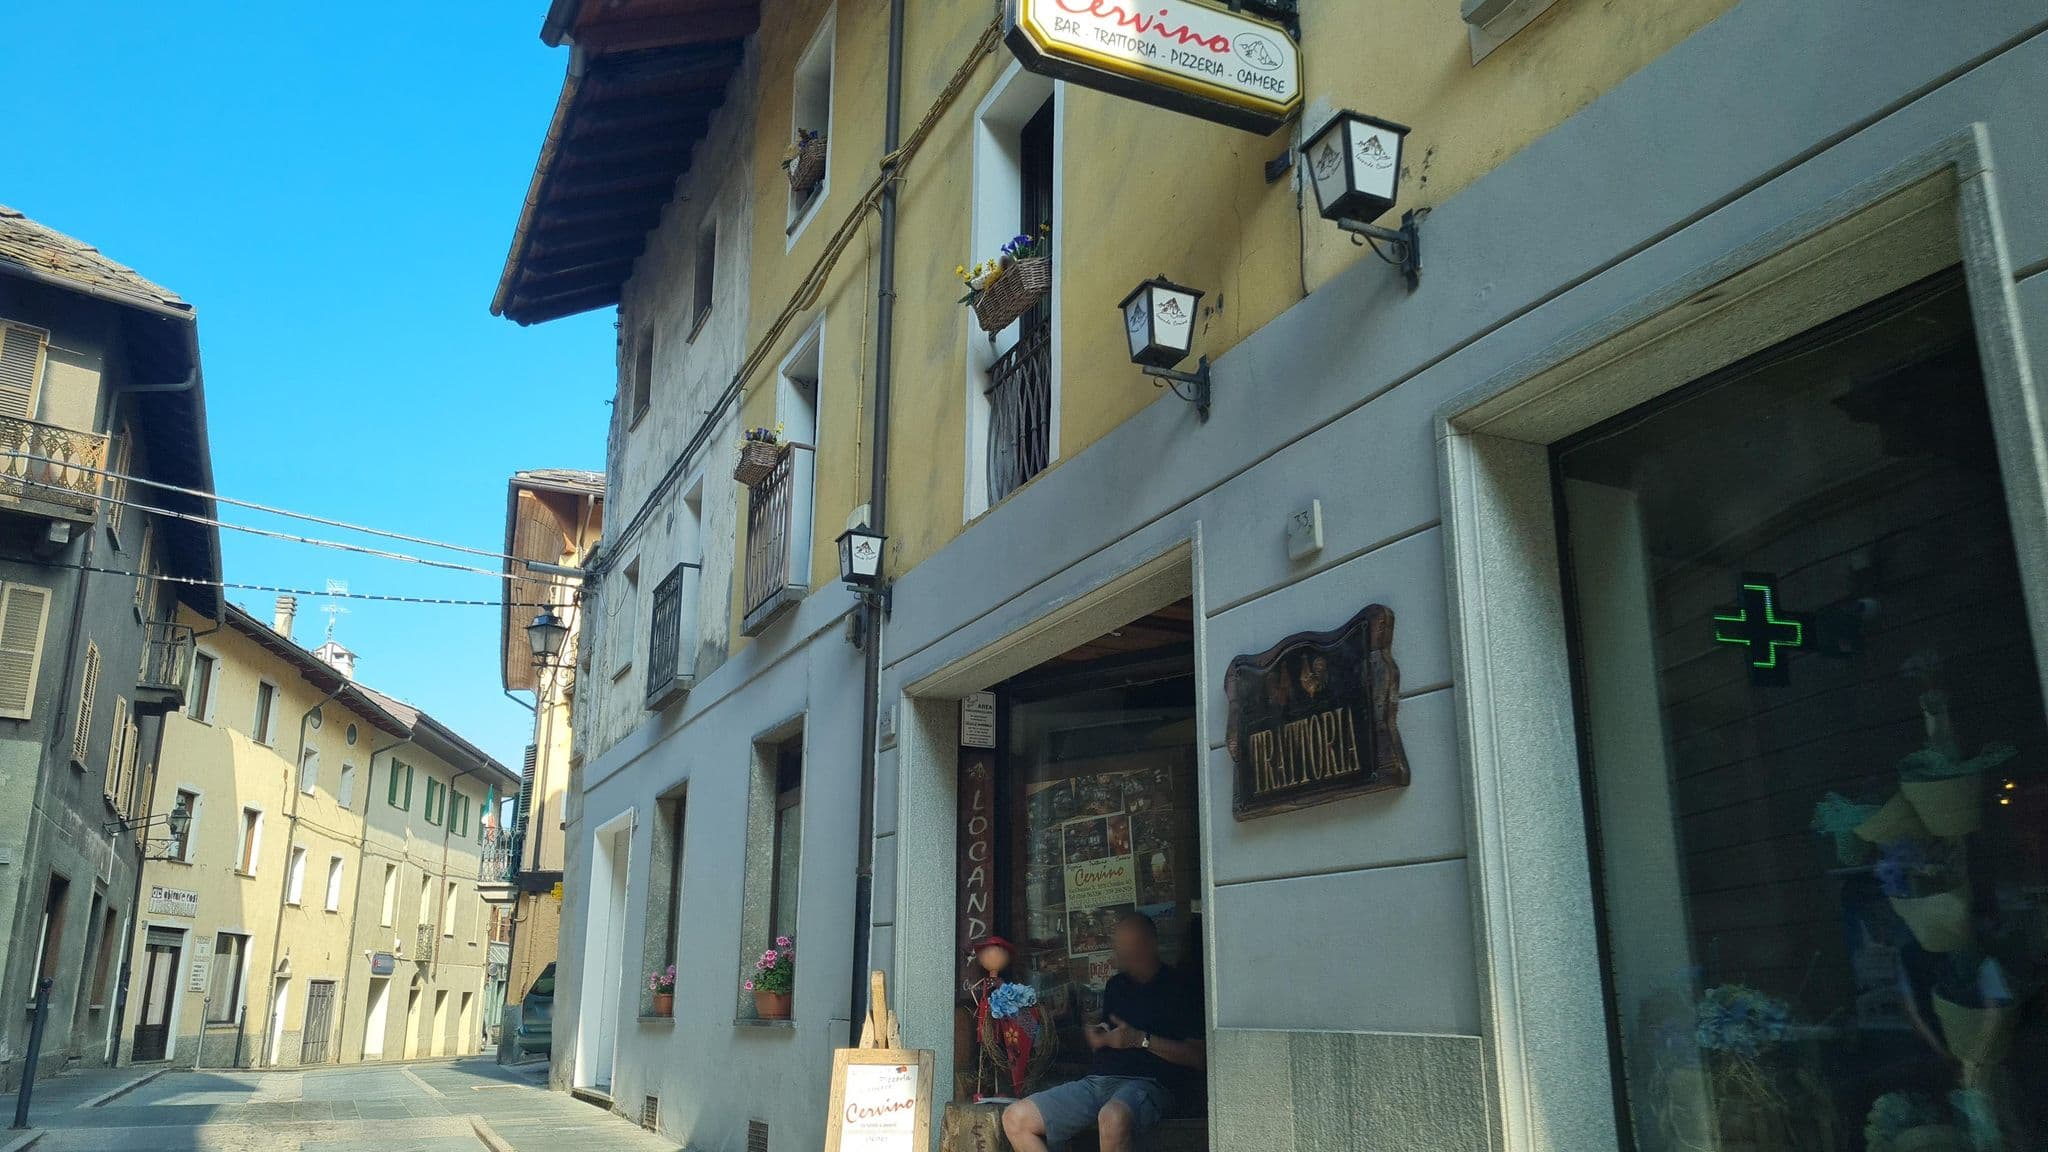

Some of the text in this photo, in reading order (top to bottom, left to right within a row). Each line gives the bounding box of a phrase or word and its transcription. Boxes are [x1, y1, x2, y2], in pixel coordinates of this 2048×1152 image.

[1055, 16, 1285, 94] BAR TRATTORIA PIZZERIA CAMERE
[1249, 706, 1360, 794] TRATTORIA
[1074, 864, 1124, 887] Cervino
[846, 1099, 914, 1123] Cervino
